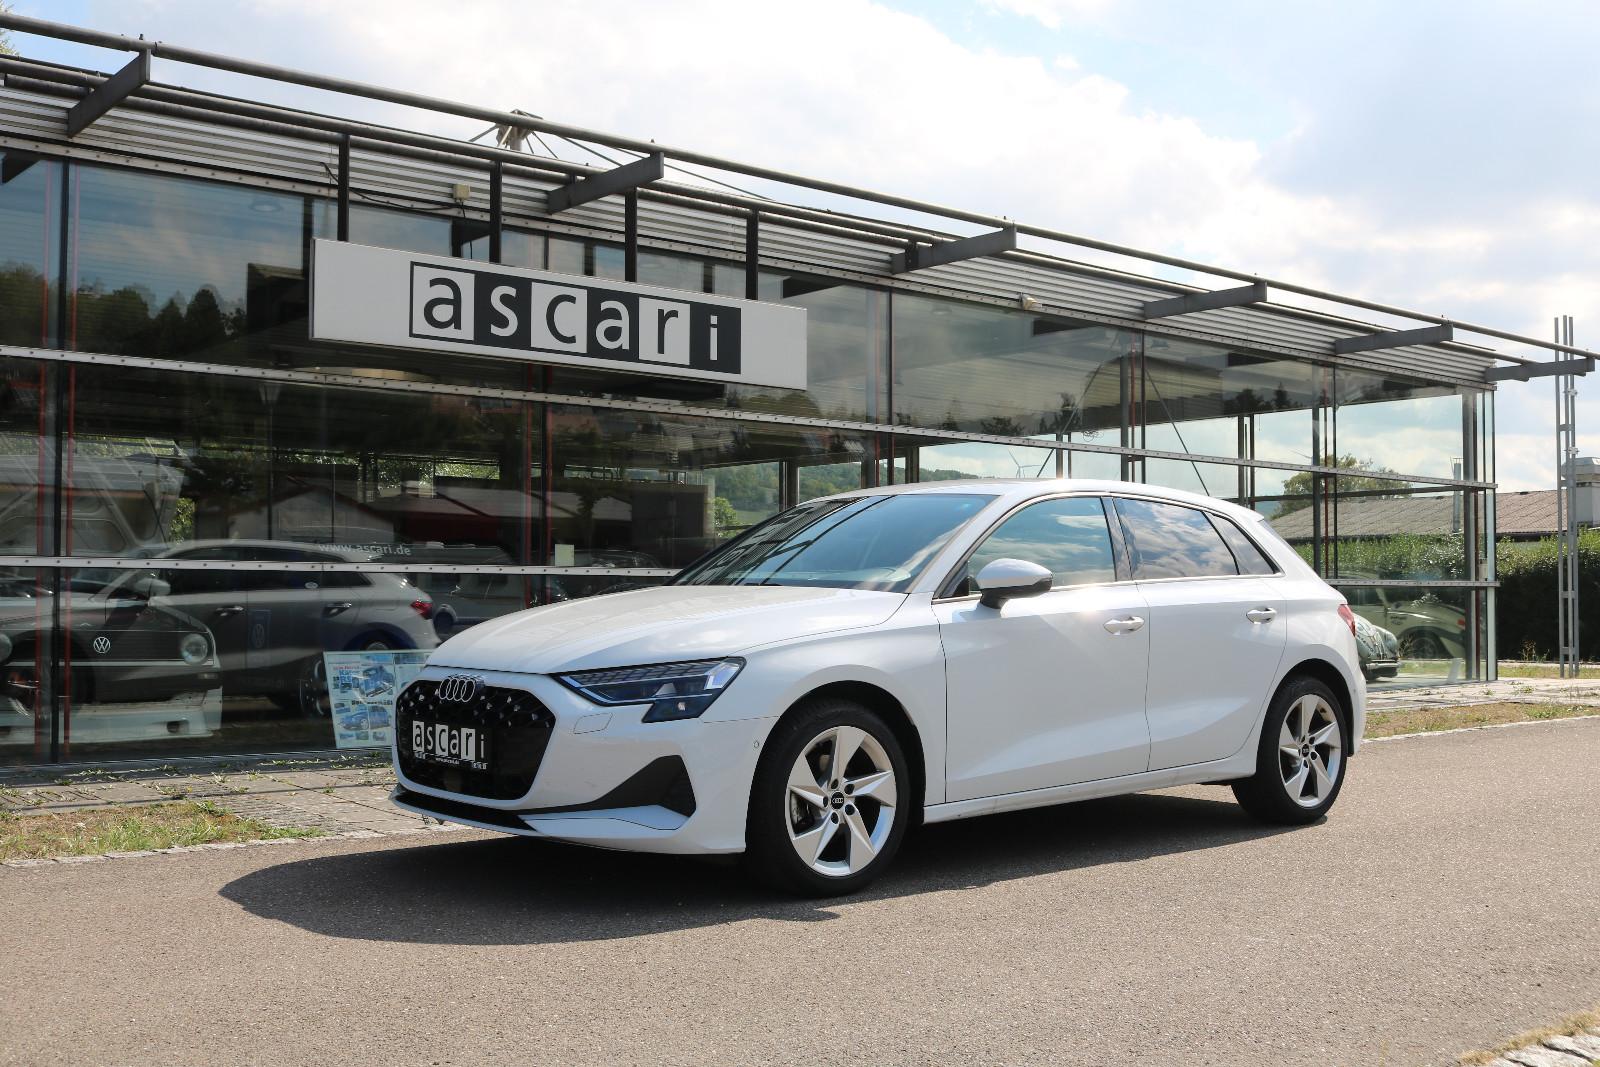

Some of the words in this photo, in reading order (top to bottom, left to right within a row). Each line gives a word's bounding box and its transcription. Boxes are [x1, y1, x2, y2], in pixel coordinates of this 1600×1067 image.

[422, 277, 718, 361] ascari
[319, 543, 412, 555] www.ascari.de
[414, 722, 486, 759] ascari
